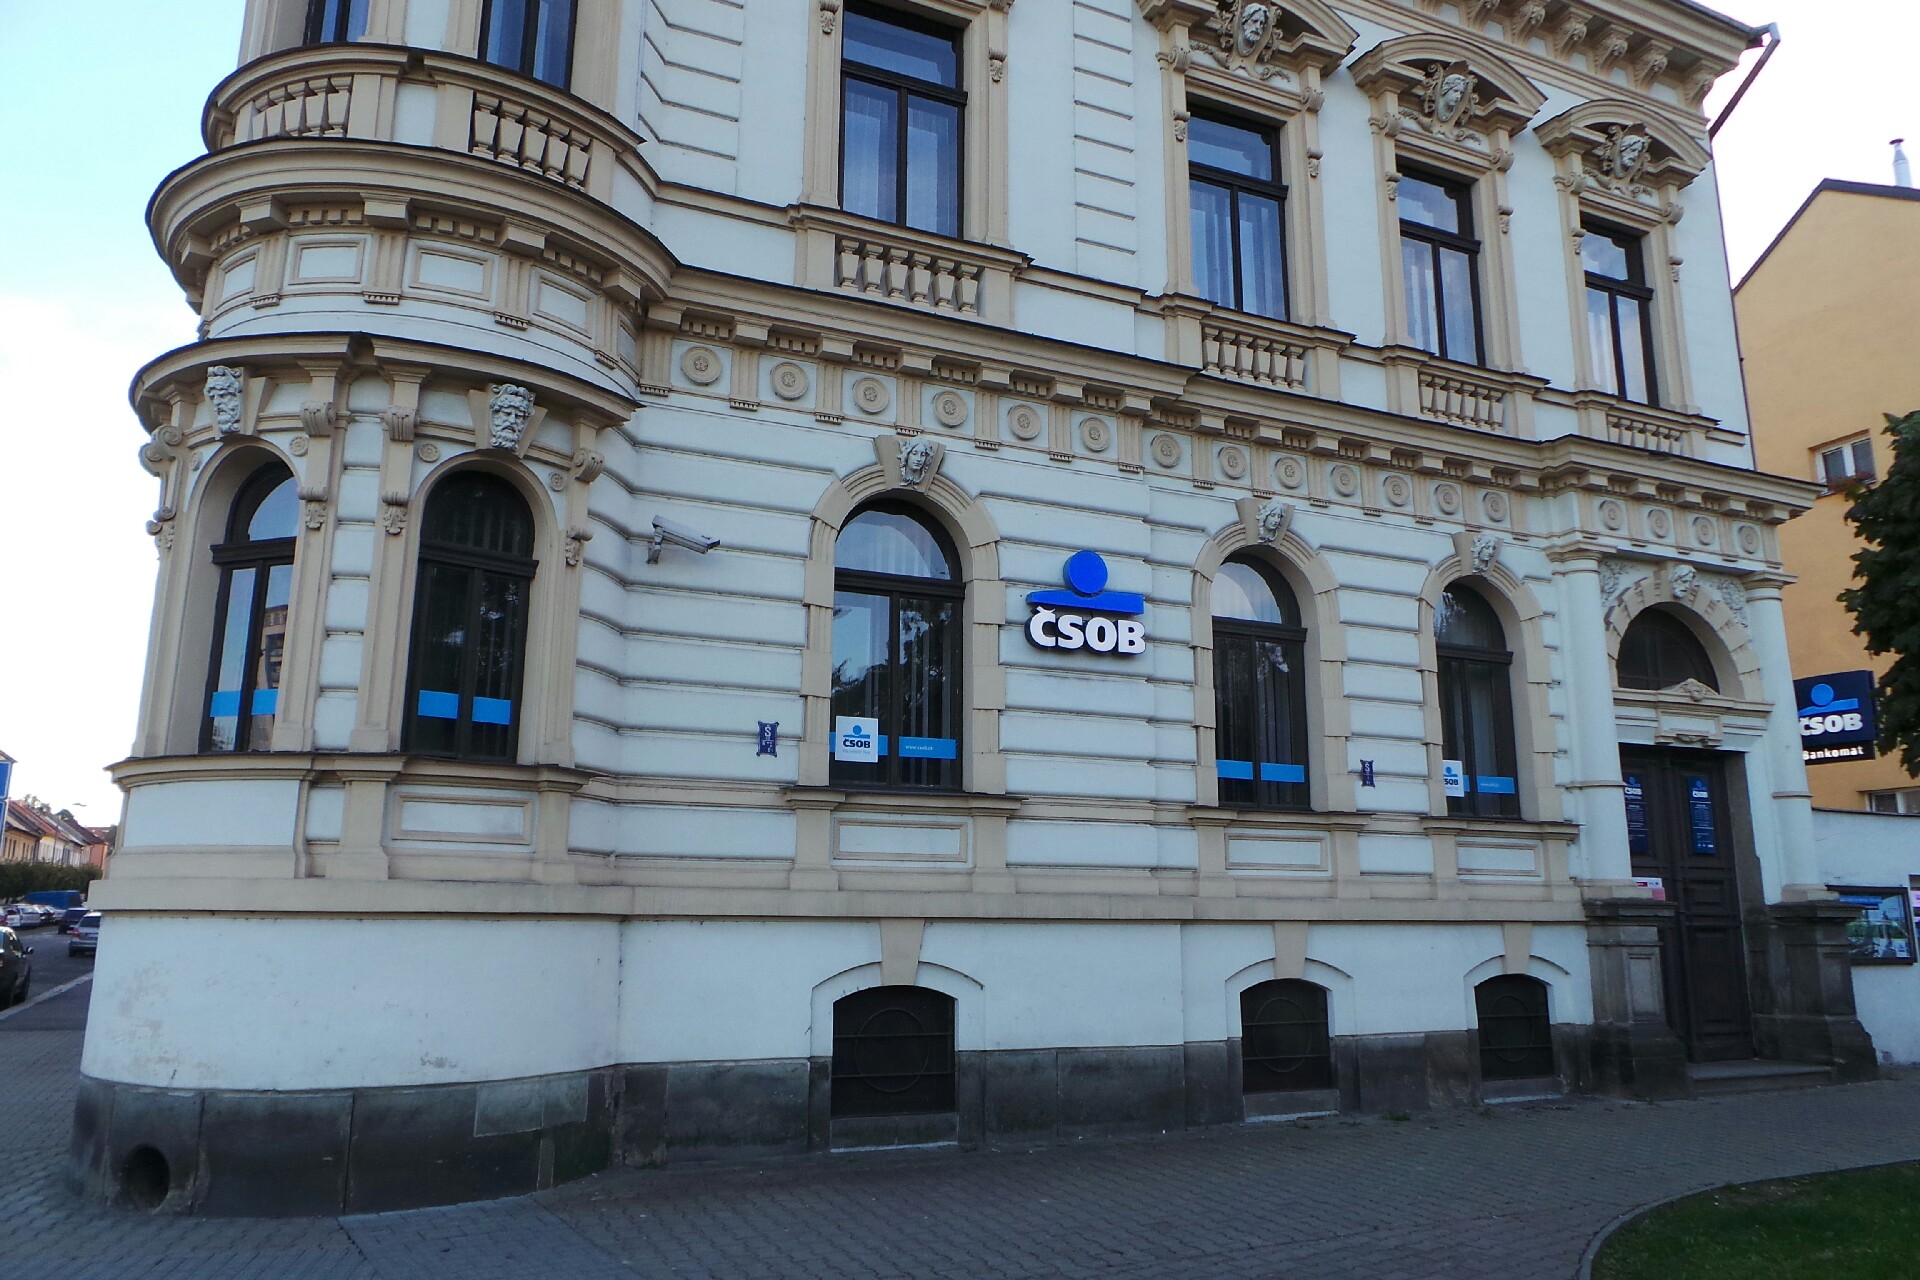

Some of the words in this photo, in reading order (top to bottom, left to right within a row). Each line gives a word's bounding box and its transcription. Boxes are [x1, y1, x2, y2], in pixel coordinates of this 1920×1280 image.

[1029, 605, 1146, 654] ČSOB
[1799, 713, 1863, 736] ČSOB
[843, 738, 870, 749] ČSOB
[1802, 746, 1864, 760] Bankomat
